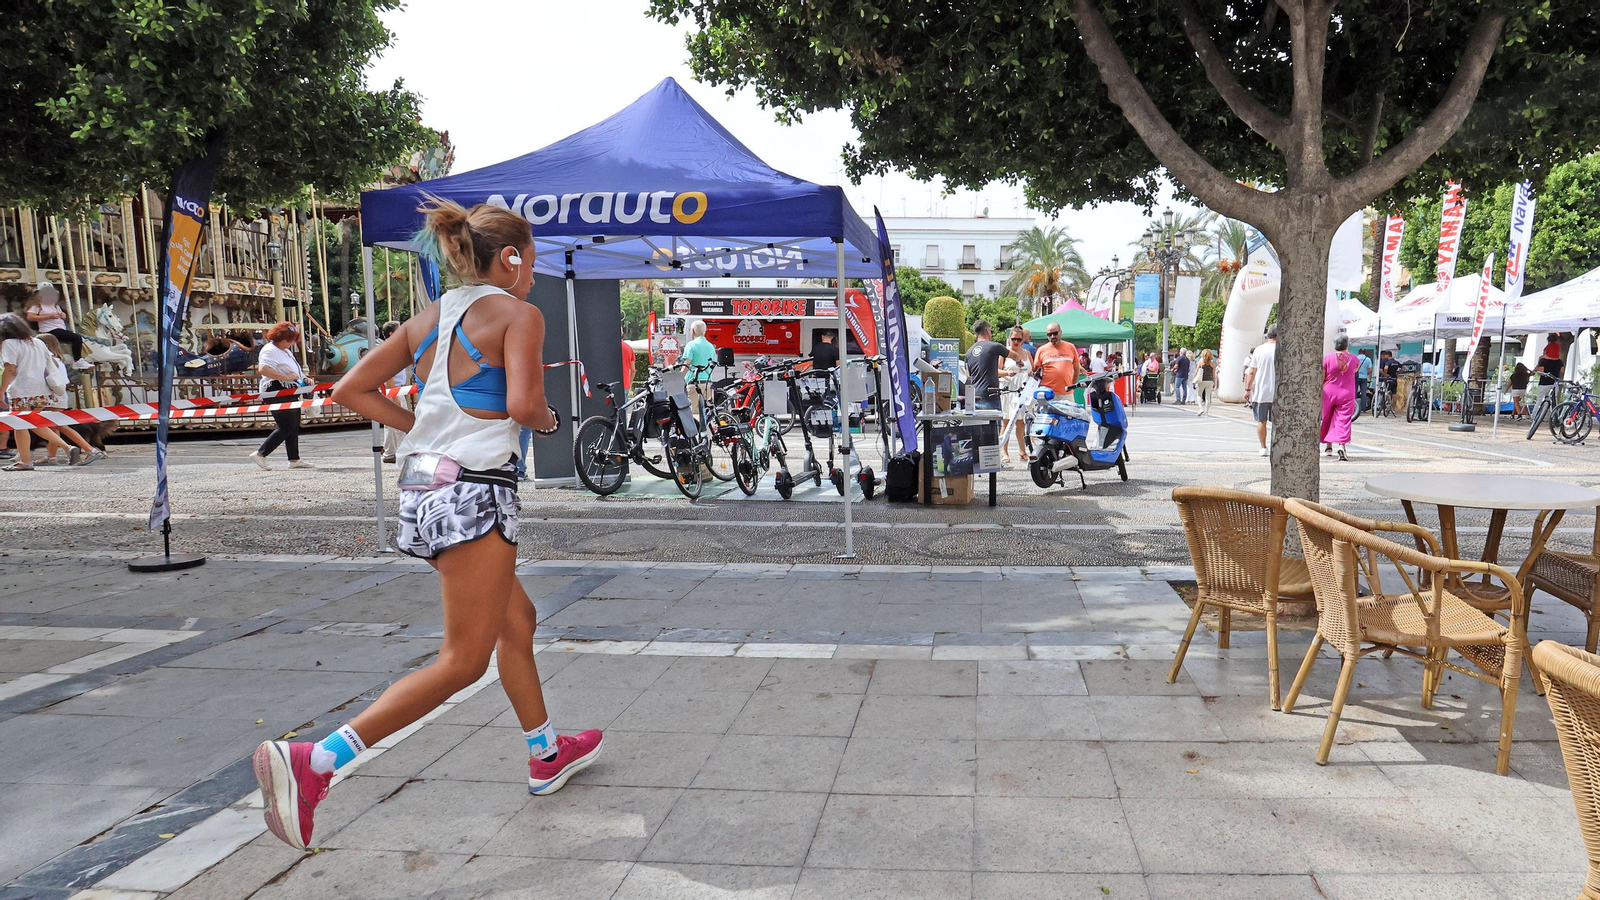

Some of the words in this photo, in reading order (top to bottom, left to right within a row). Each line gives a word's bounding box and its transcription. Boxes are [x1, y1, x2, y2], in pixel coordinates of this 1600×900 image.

[1437, 178, 1466, 265] YAMAH
[731, 299, 807, 316] TODOBIKE
[733, 335, 766, 343] TODOBIKE
